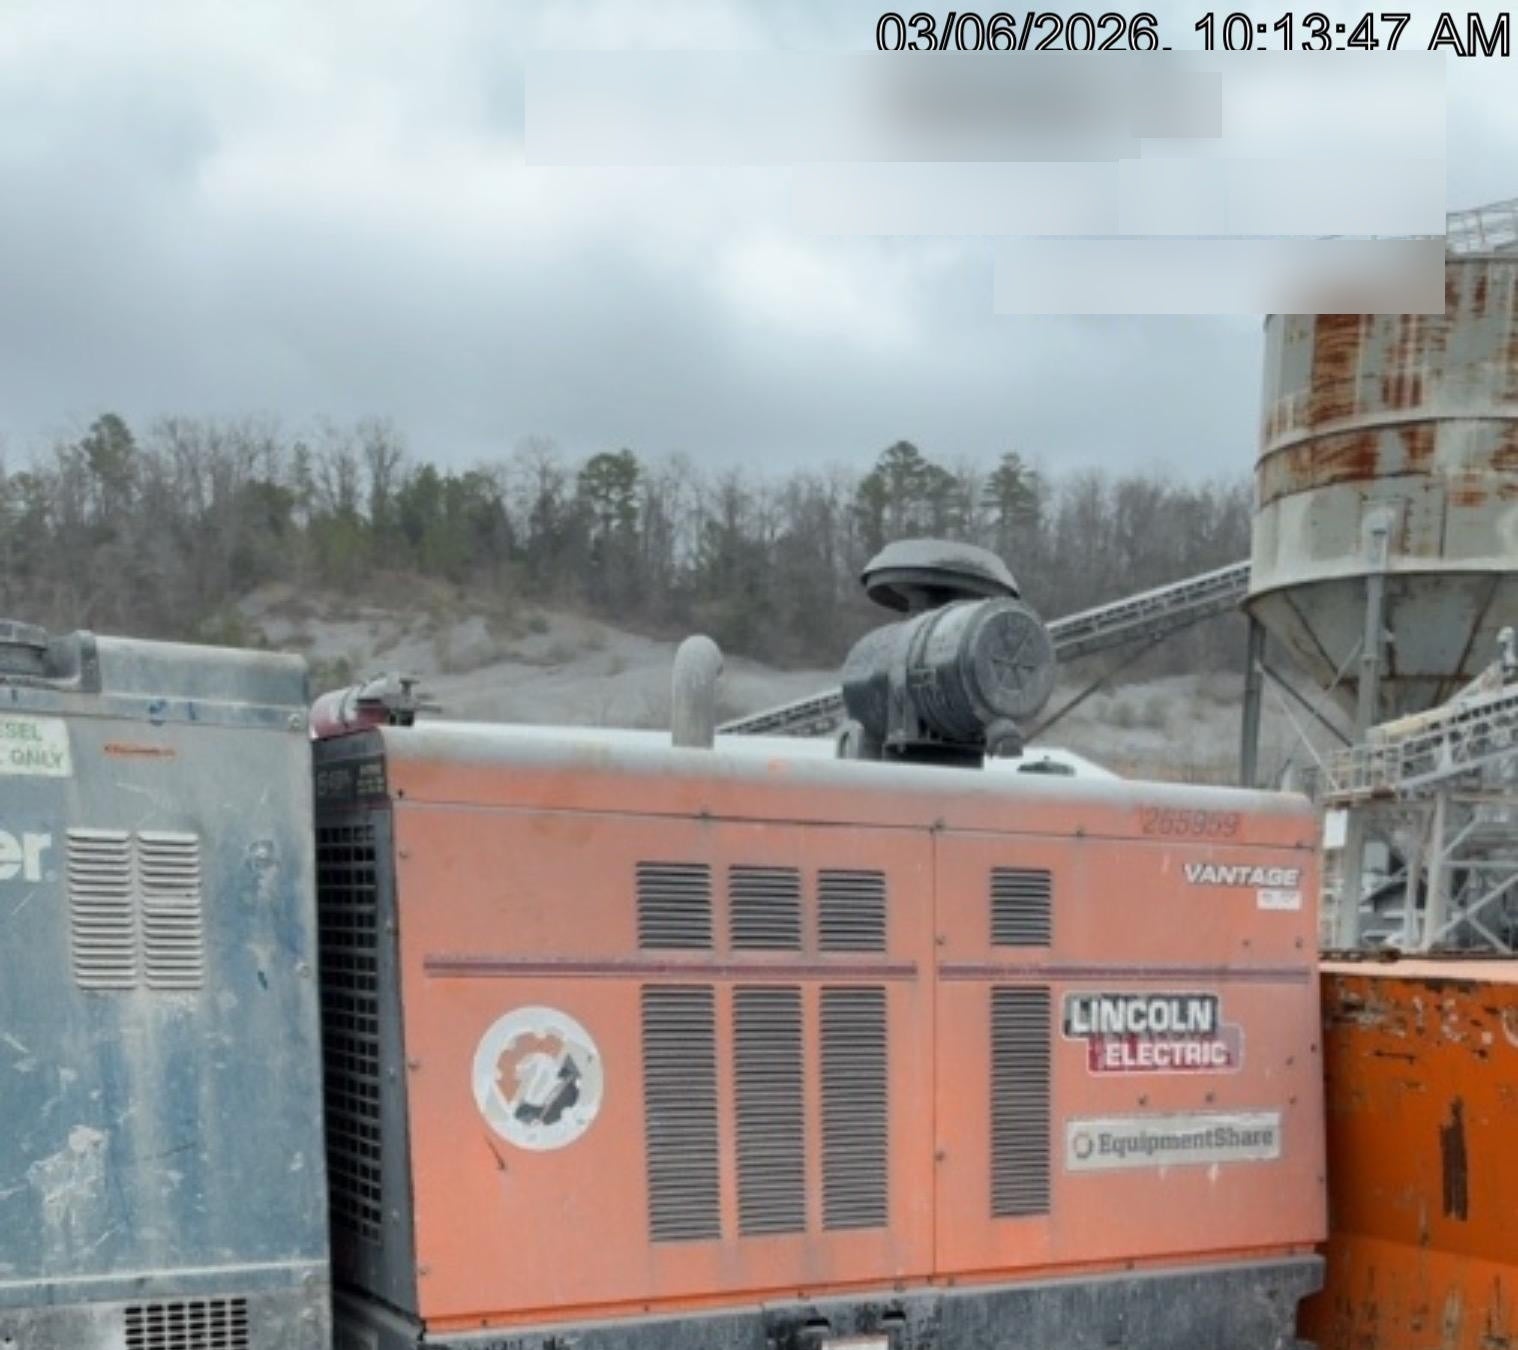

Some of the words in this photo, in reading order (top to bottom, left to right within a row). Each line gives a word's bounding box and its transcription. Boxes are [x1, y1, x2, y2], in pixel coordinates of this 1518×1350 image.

[0, 722, 43, 742] SEL
[10, 748, 64, 768] ONLY
[1183, 863, 1300, 887] VANTAGE
[1070, 998, 1213, 1034] LINCOLN
[1105, 1041, 1229, 1067] ELECTRIC
[1097, 1127, 1274, 1158] EquipmentShare
